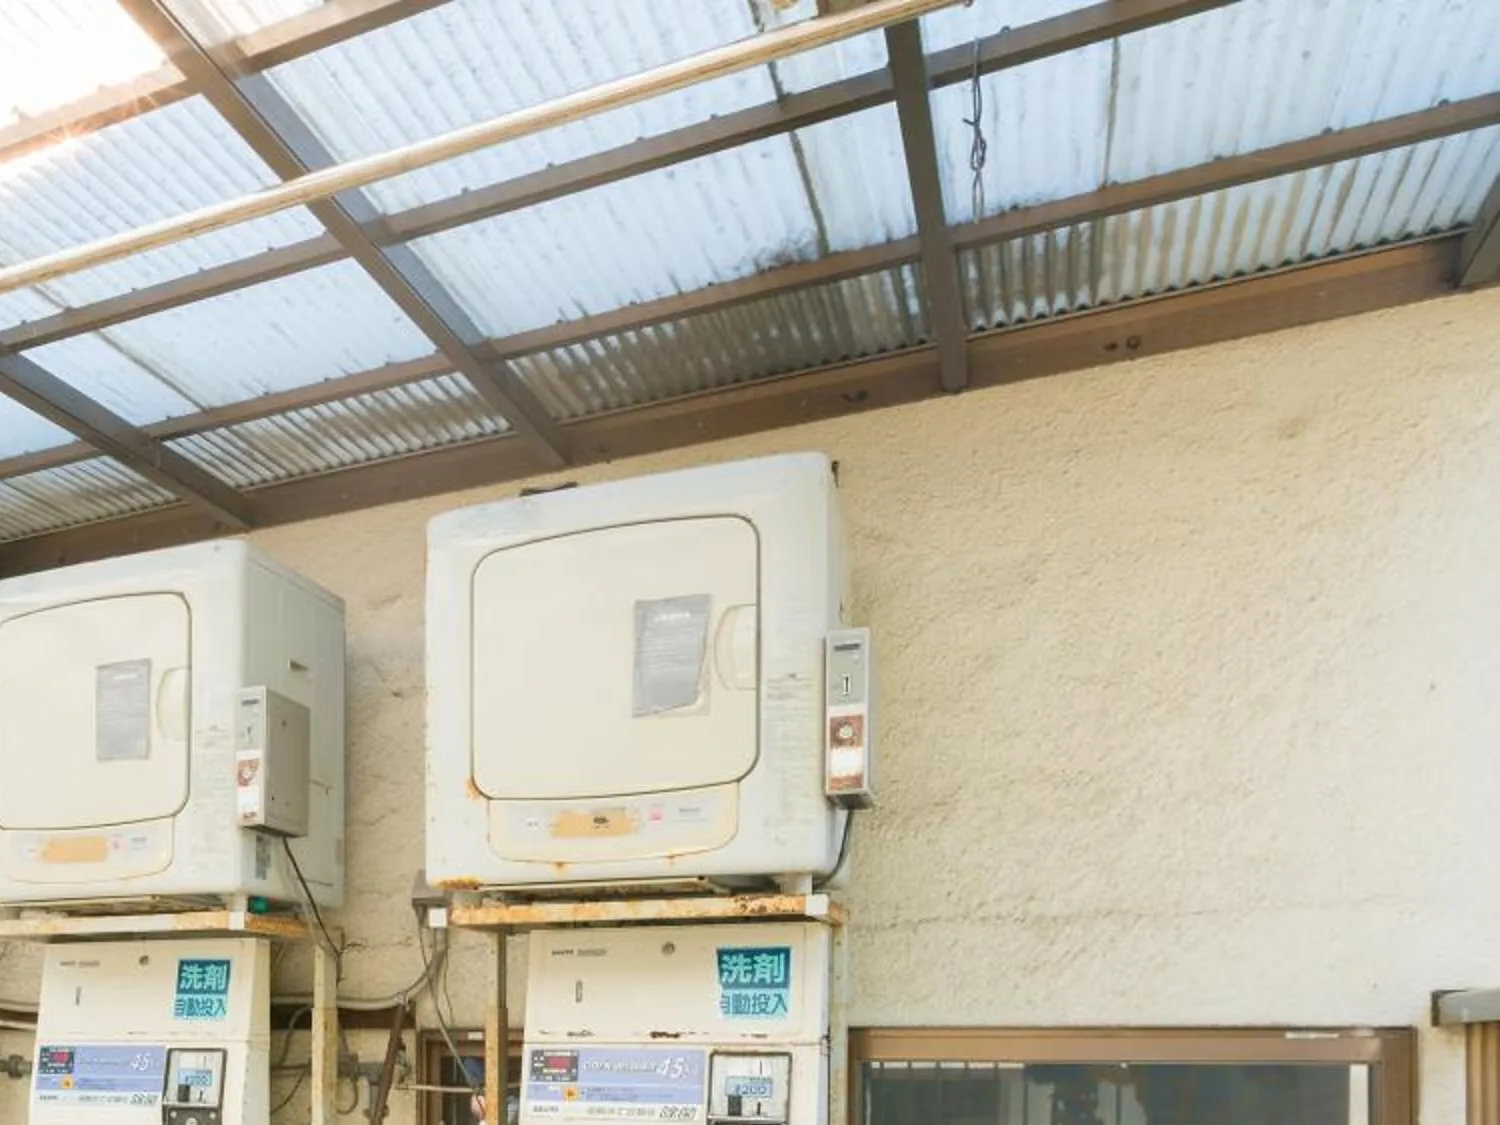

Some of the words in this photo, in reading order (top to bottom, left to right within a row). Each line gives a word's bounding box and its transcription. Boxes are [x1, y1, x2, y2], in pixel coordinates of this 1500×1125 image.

[180, 964, 227, 990] 洗剤
[721, 952, 785, 984] 洗剤
[174, 998, 226, 1016] 自動投入
[720, 993, 788, 1014] 自動投入
